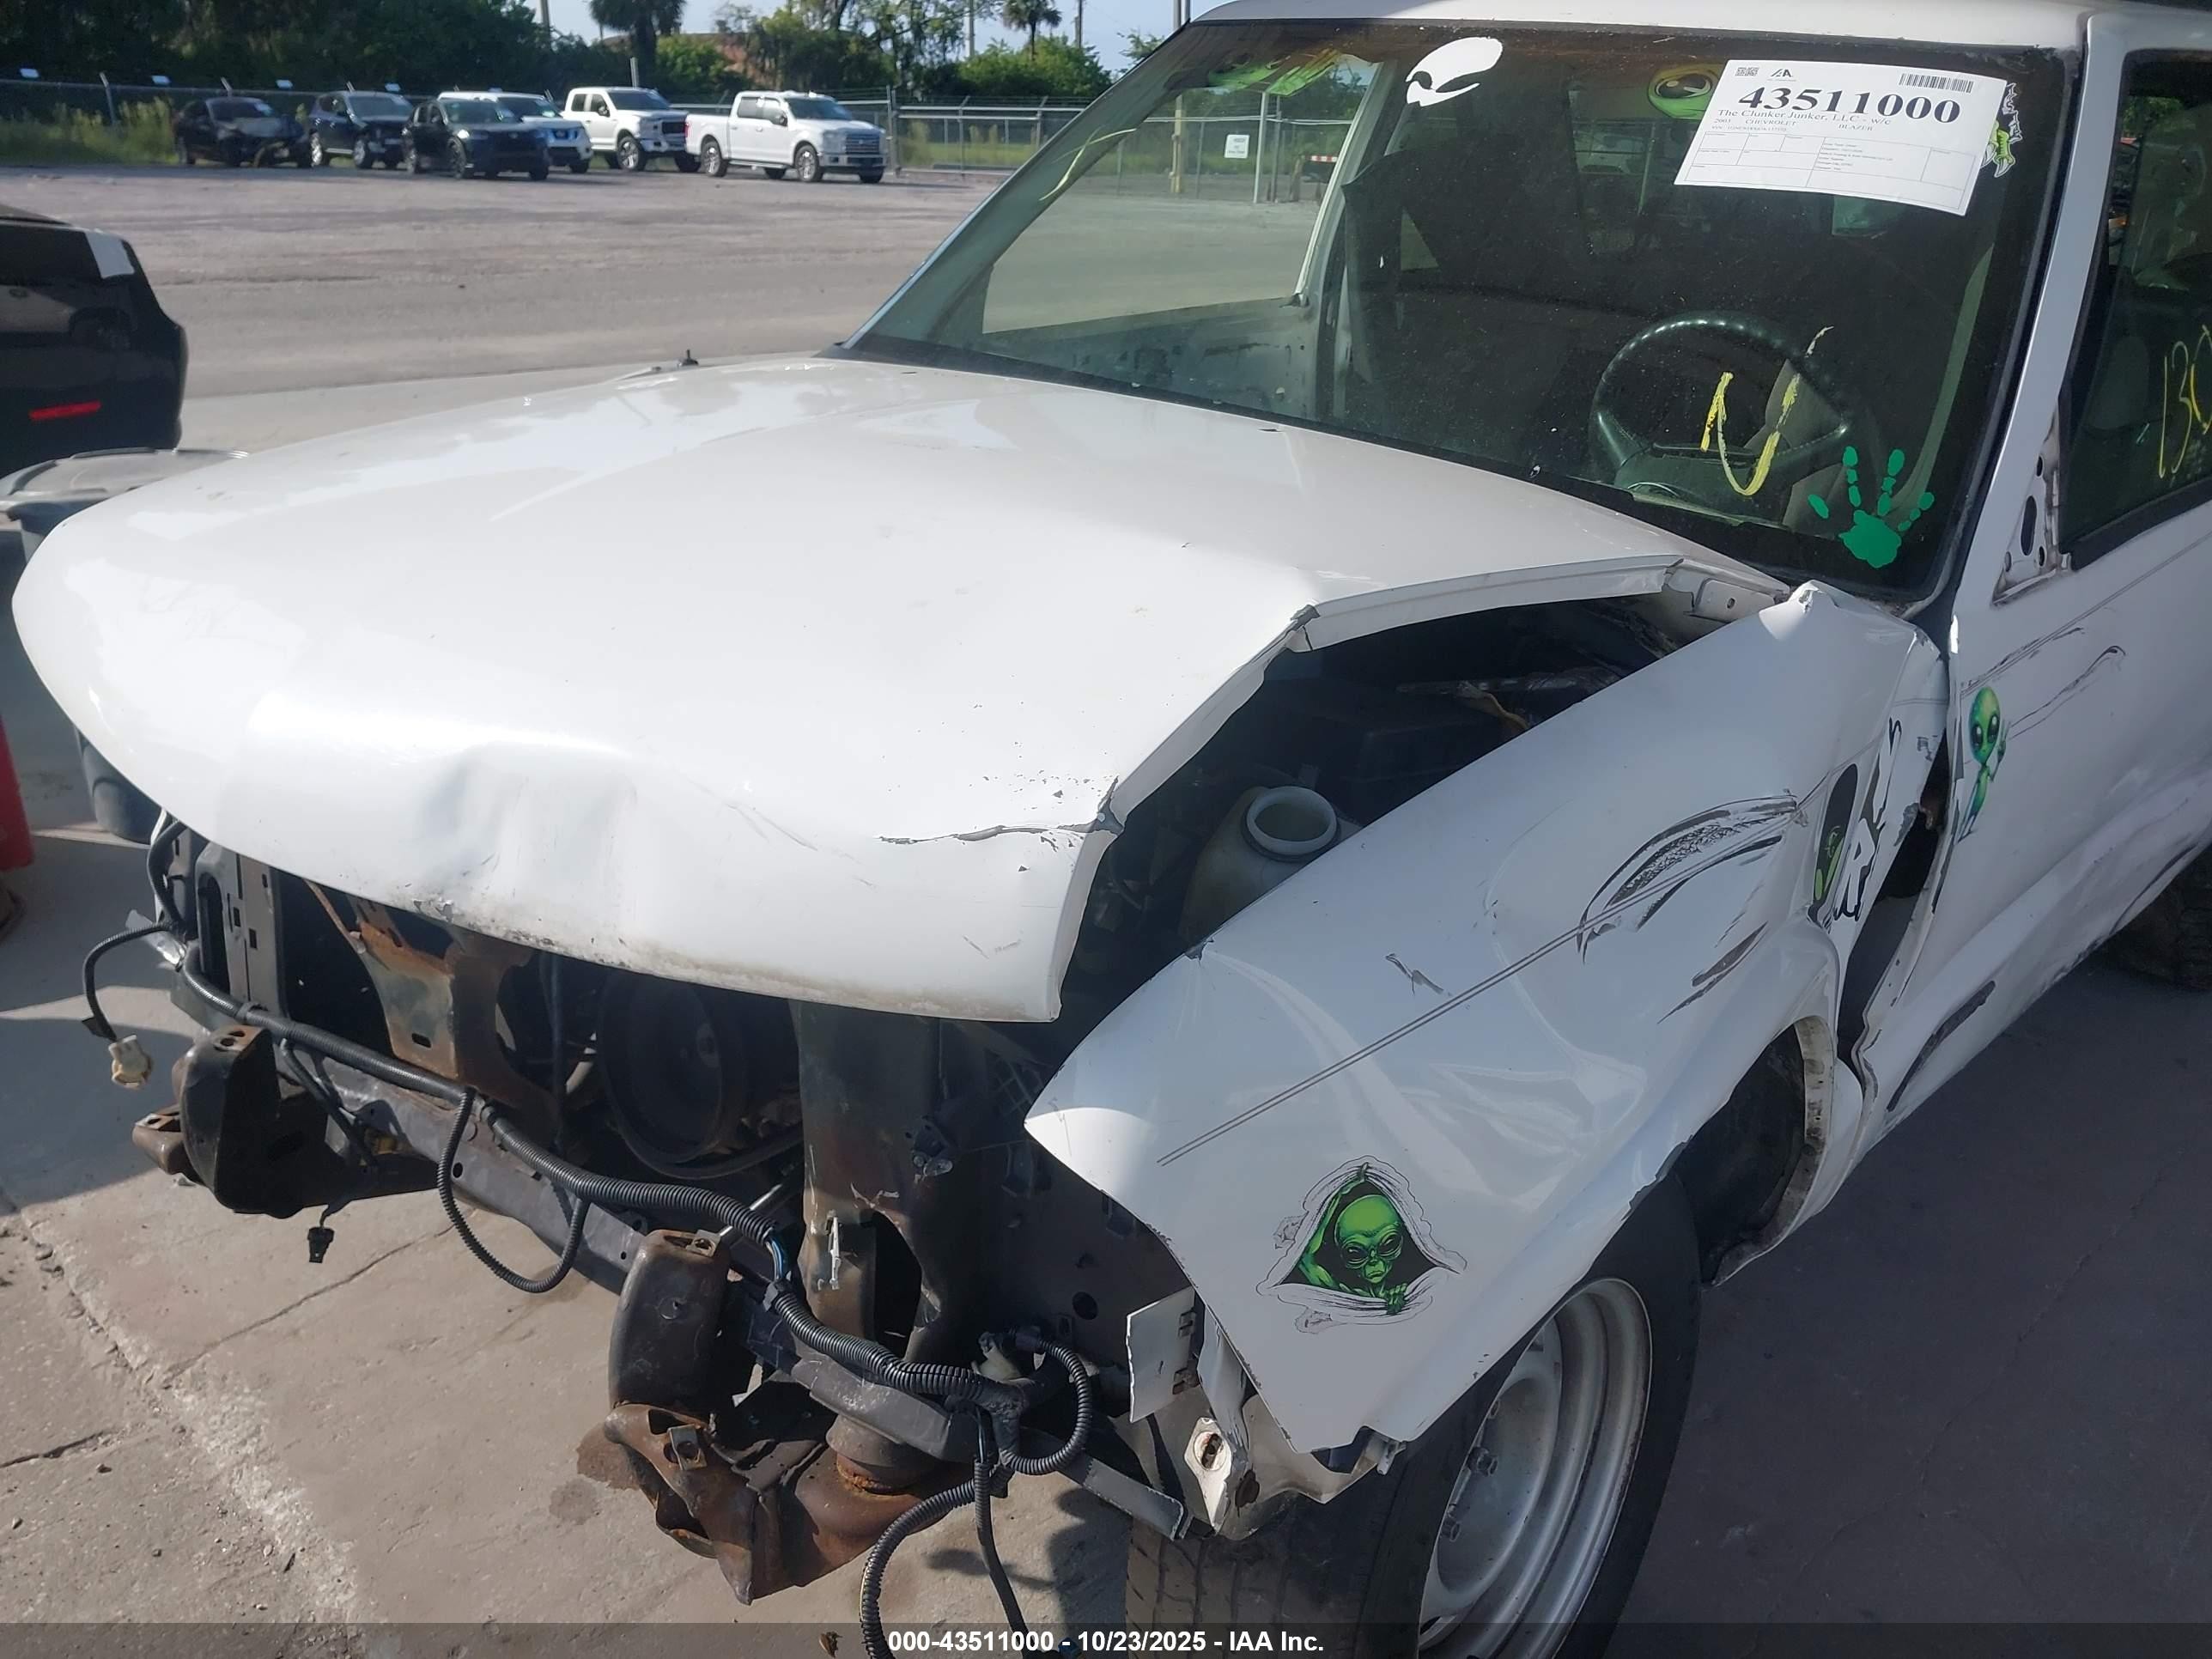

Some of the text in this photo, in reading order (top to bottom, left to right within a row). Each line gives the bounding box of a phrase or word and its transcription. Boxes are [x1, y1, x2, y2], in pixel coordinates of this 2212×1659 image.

[1737, 87, 1960, 124] 43511000
[1741, 110, 1786, 118] Clunker
[1832, 114, 1859, 123] LLC
